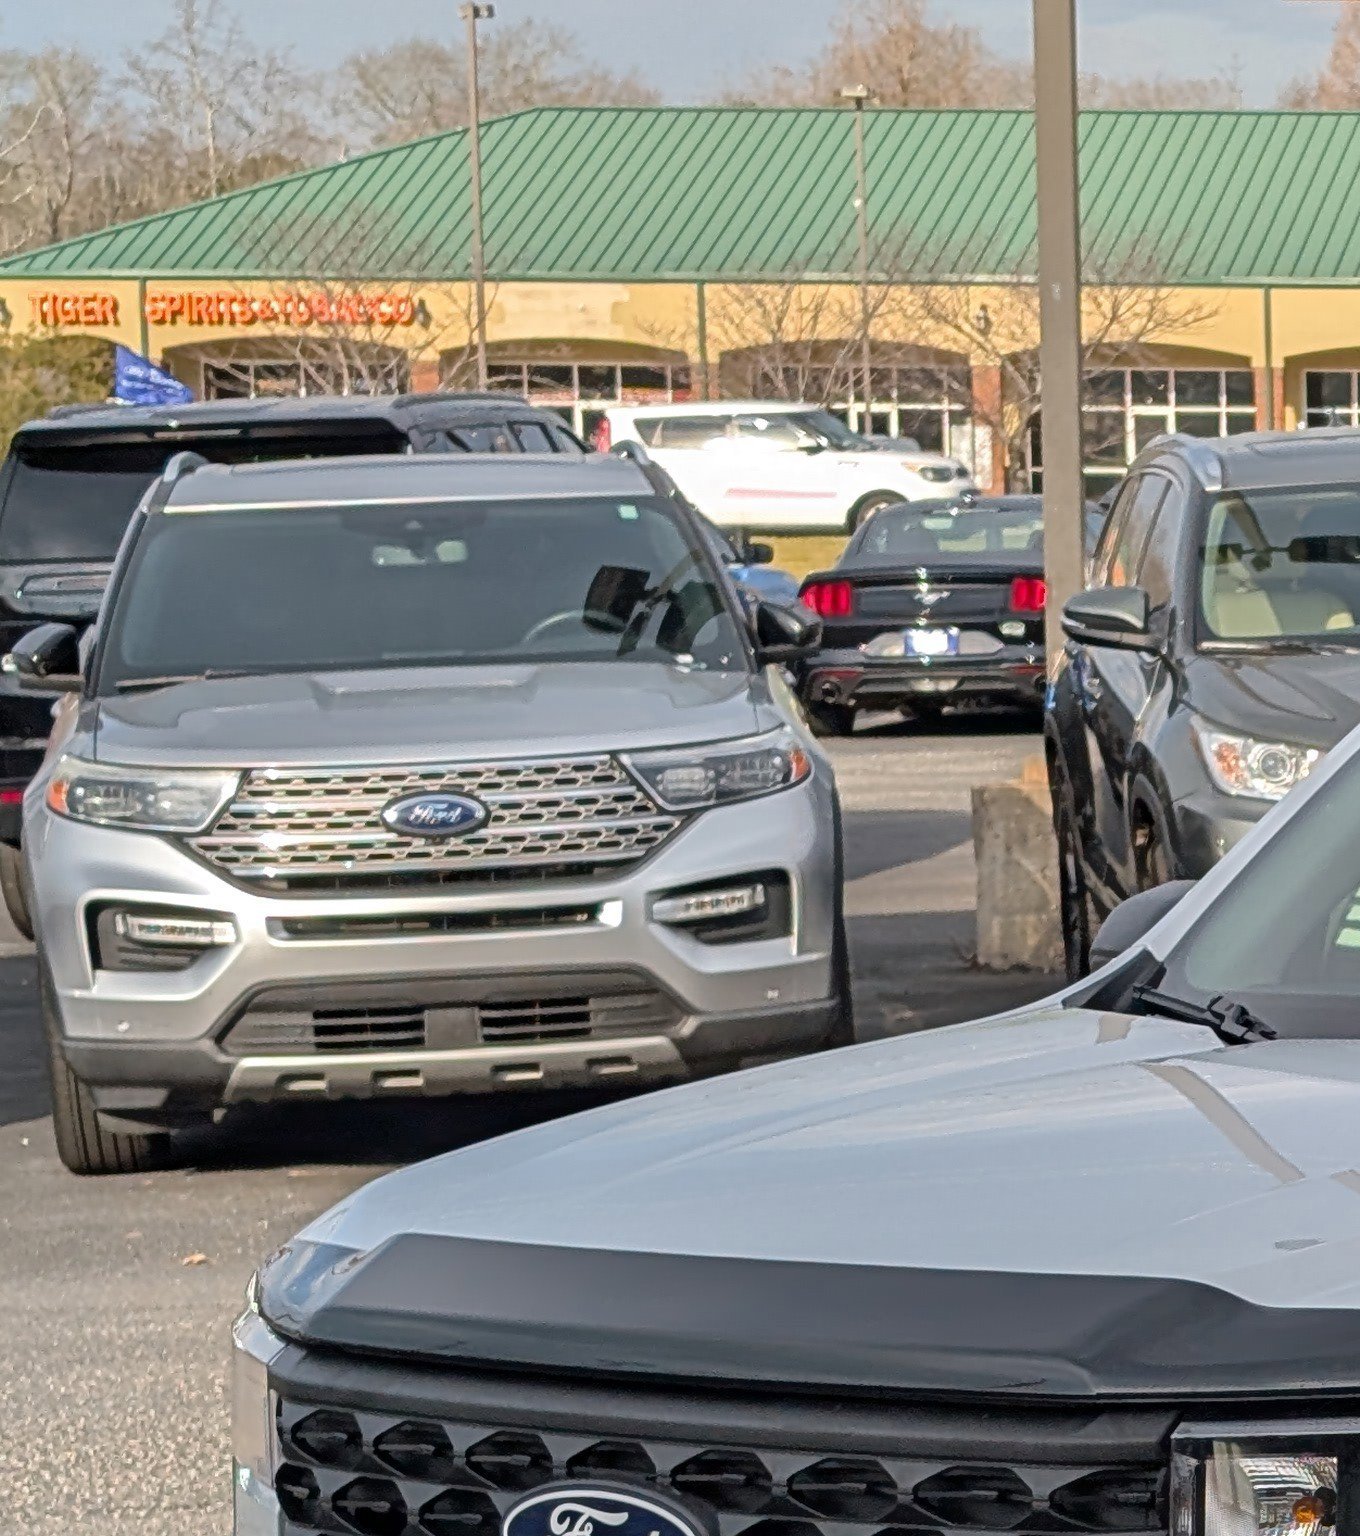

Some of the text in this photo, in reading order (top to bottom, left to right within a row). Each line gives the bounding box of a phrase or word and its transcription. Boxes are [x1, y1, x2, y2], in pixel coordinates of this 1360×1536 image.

[28, 290, 119, 326] TIGER
[145, 291, 253, 326] SPIRITS
[406, 802, 463, 825] Ford
